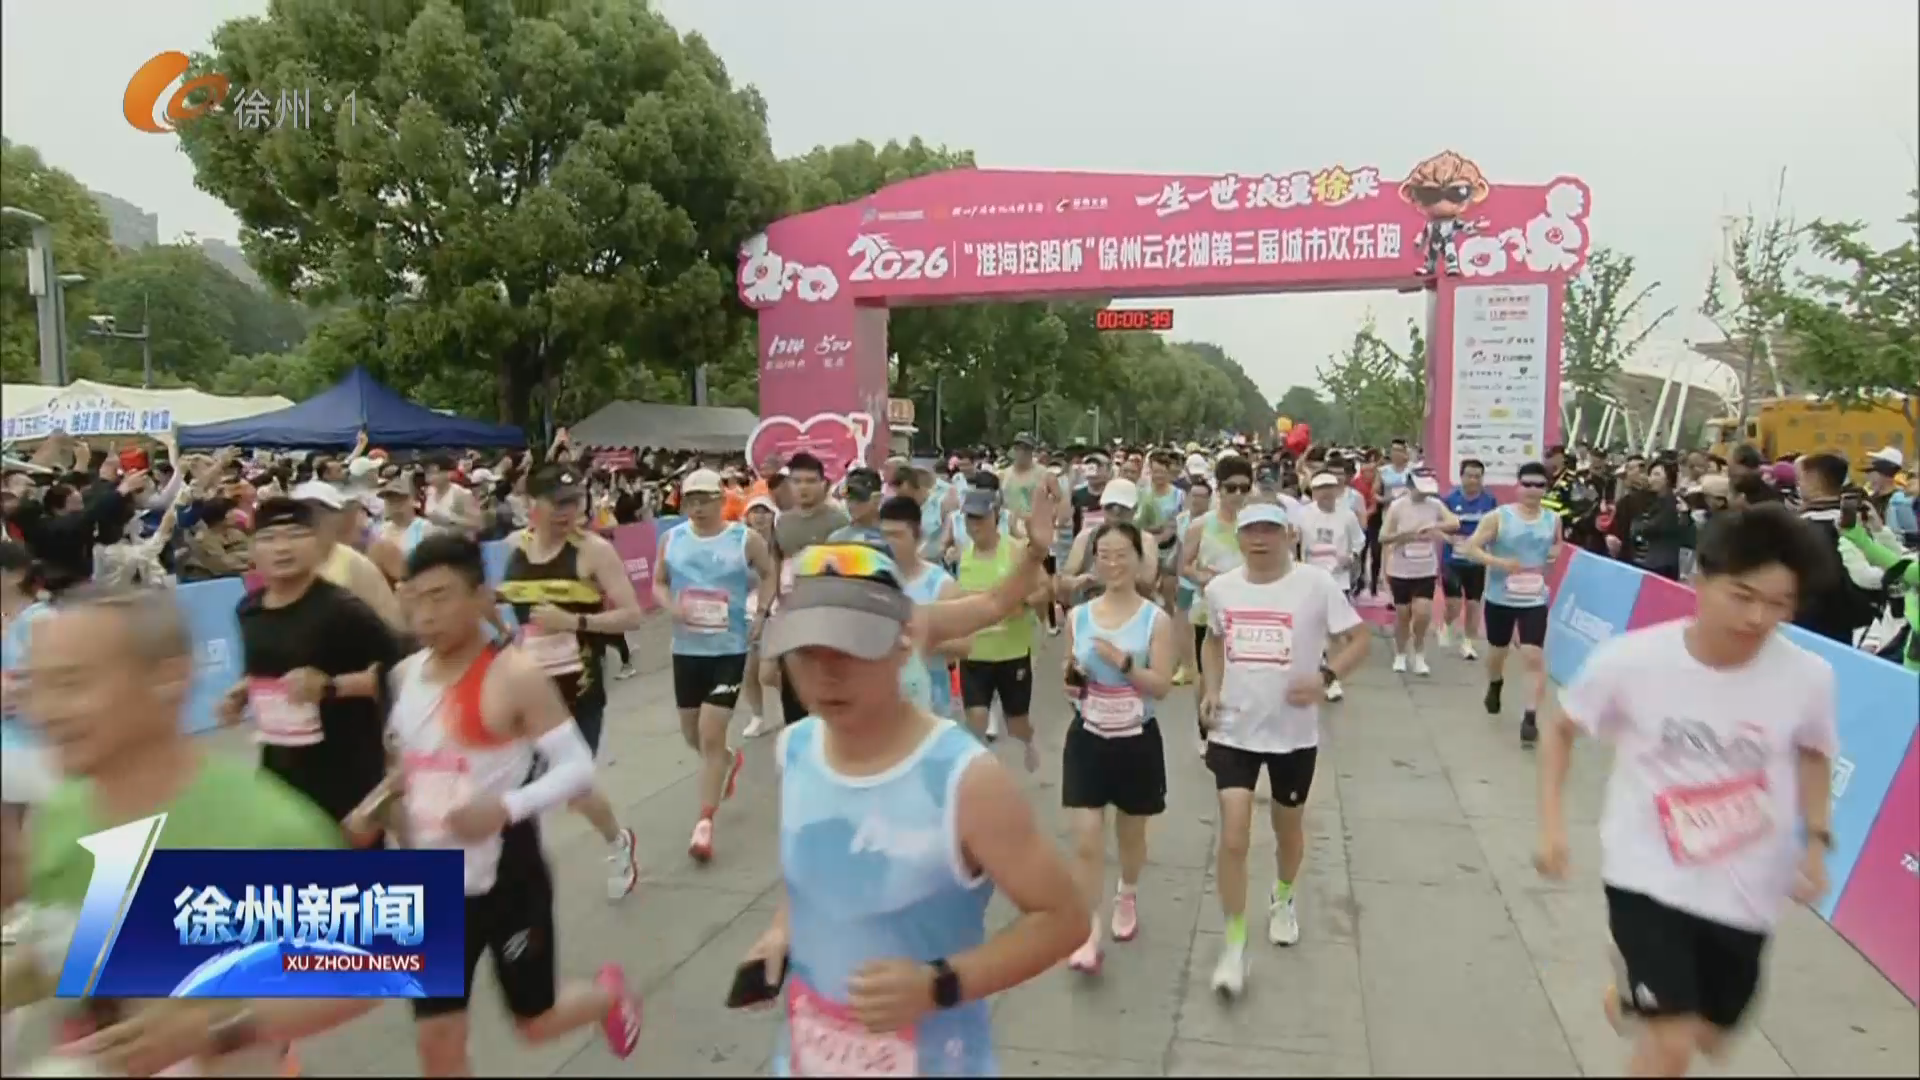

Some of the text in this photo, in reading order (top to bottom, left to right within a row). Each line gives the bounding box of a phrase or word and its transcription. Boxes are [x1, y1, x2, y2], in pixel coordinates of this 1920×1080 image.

[1135, 165, 1380, 216] 一生一世 浪漫徐来
[849, 236, 949, 281] 2026
